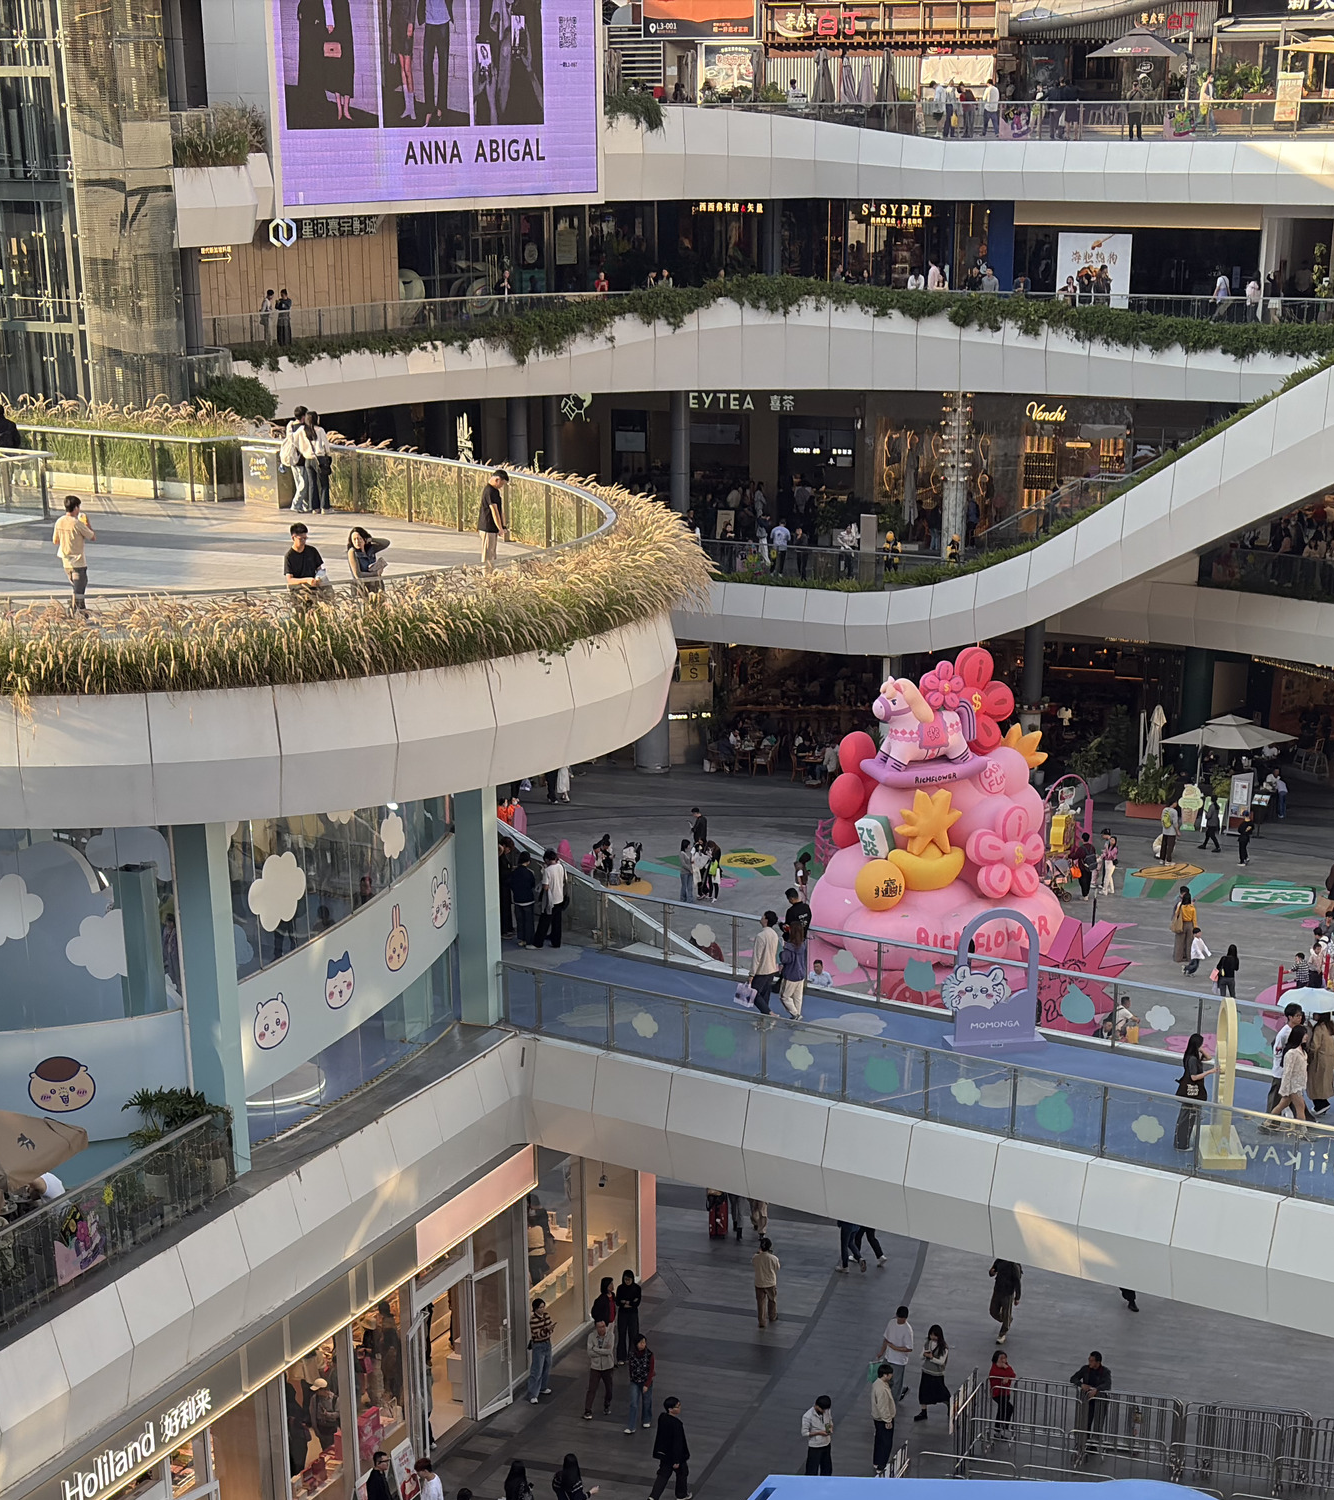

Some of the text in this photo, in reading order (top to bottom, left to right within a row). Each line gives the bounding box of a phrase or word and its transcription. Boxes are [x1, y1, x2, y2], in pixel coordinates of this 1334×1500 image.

[404, 137, 546, 166] ANNA ABIGAL
[861, 202, 933, 217] SSYPHE
[770, 394, 795, 411] 喜茶
[1025, 401, 1068, 422] Venchi
[914, 772, 958, 784] RICHFLOWER
[970, 1020, 1020, 1030] MOMONGA
[160, 1387, 213, 1442] 好利来
